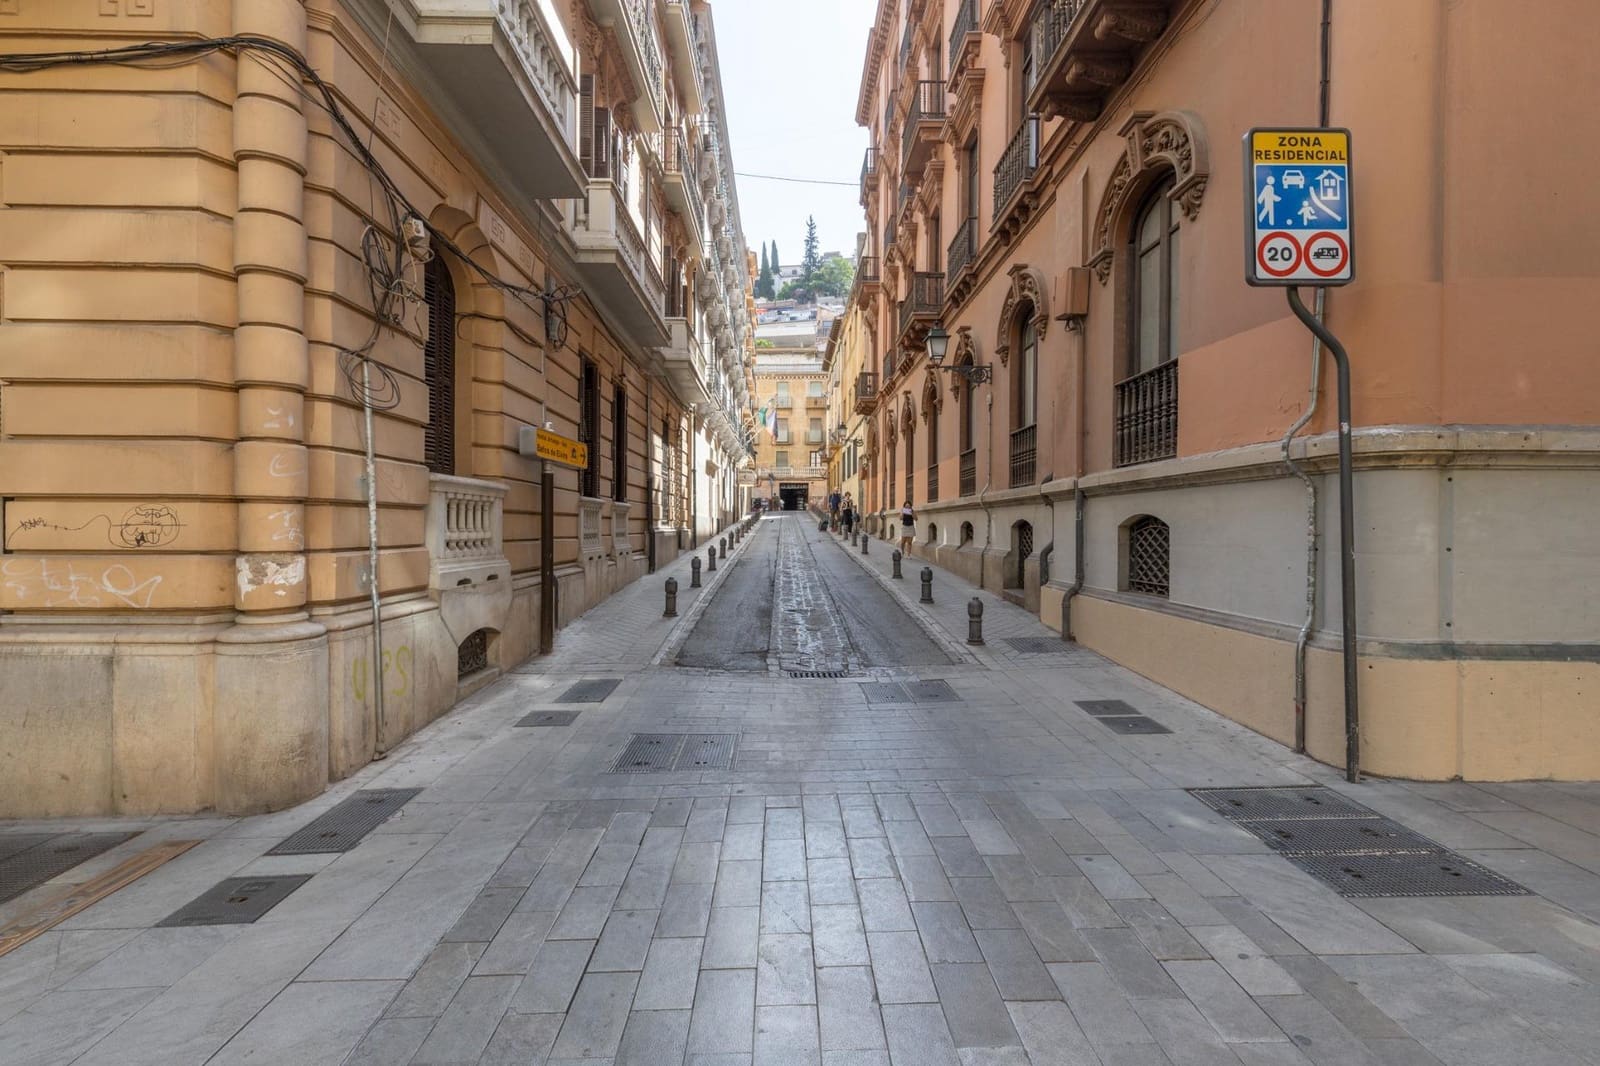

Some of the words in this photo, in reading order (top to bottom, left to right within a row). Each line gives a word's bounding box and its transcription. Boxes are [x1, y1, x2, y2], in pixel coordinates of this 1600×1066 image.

[1278, 136, 1322, 147] ZONA
[1255, 150, 1346, 161] RESIDENCIAL
[1267, 246, 1293, 262] 20
